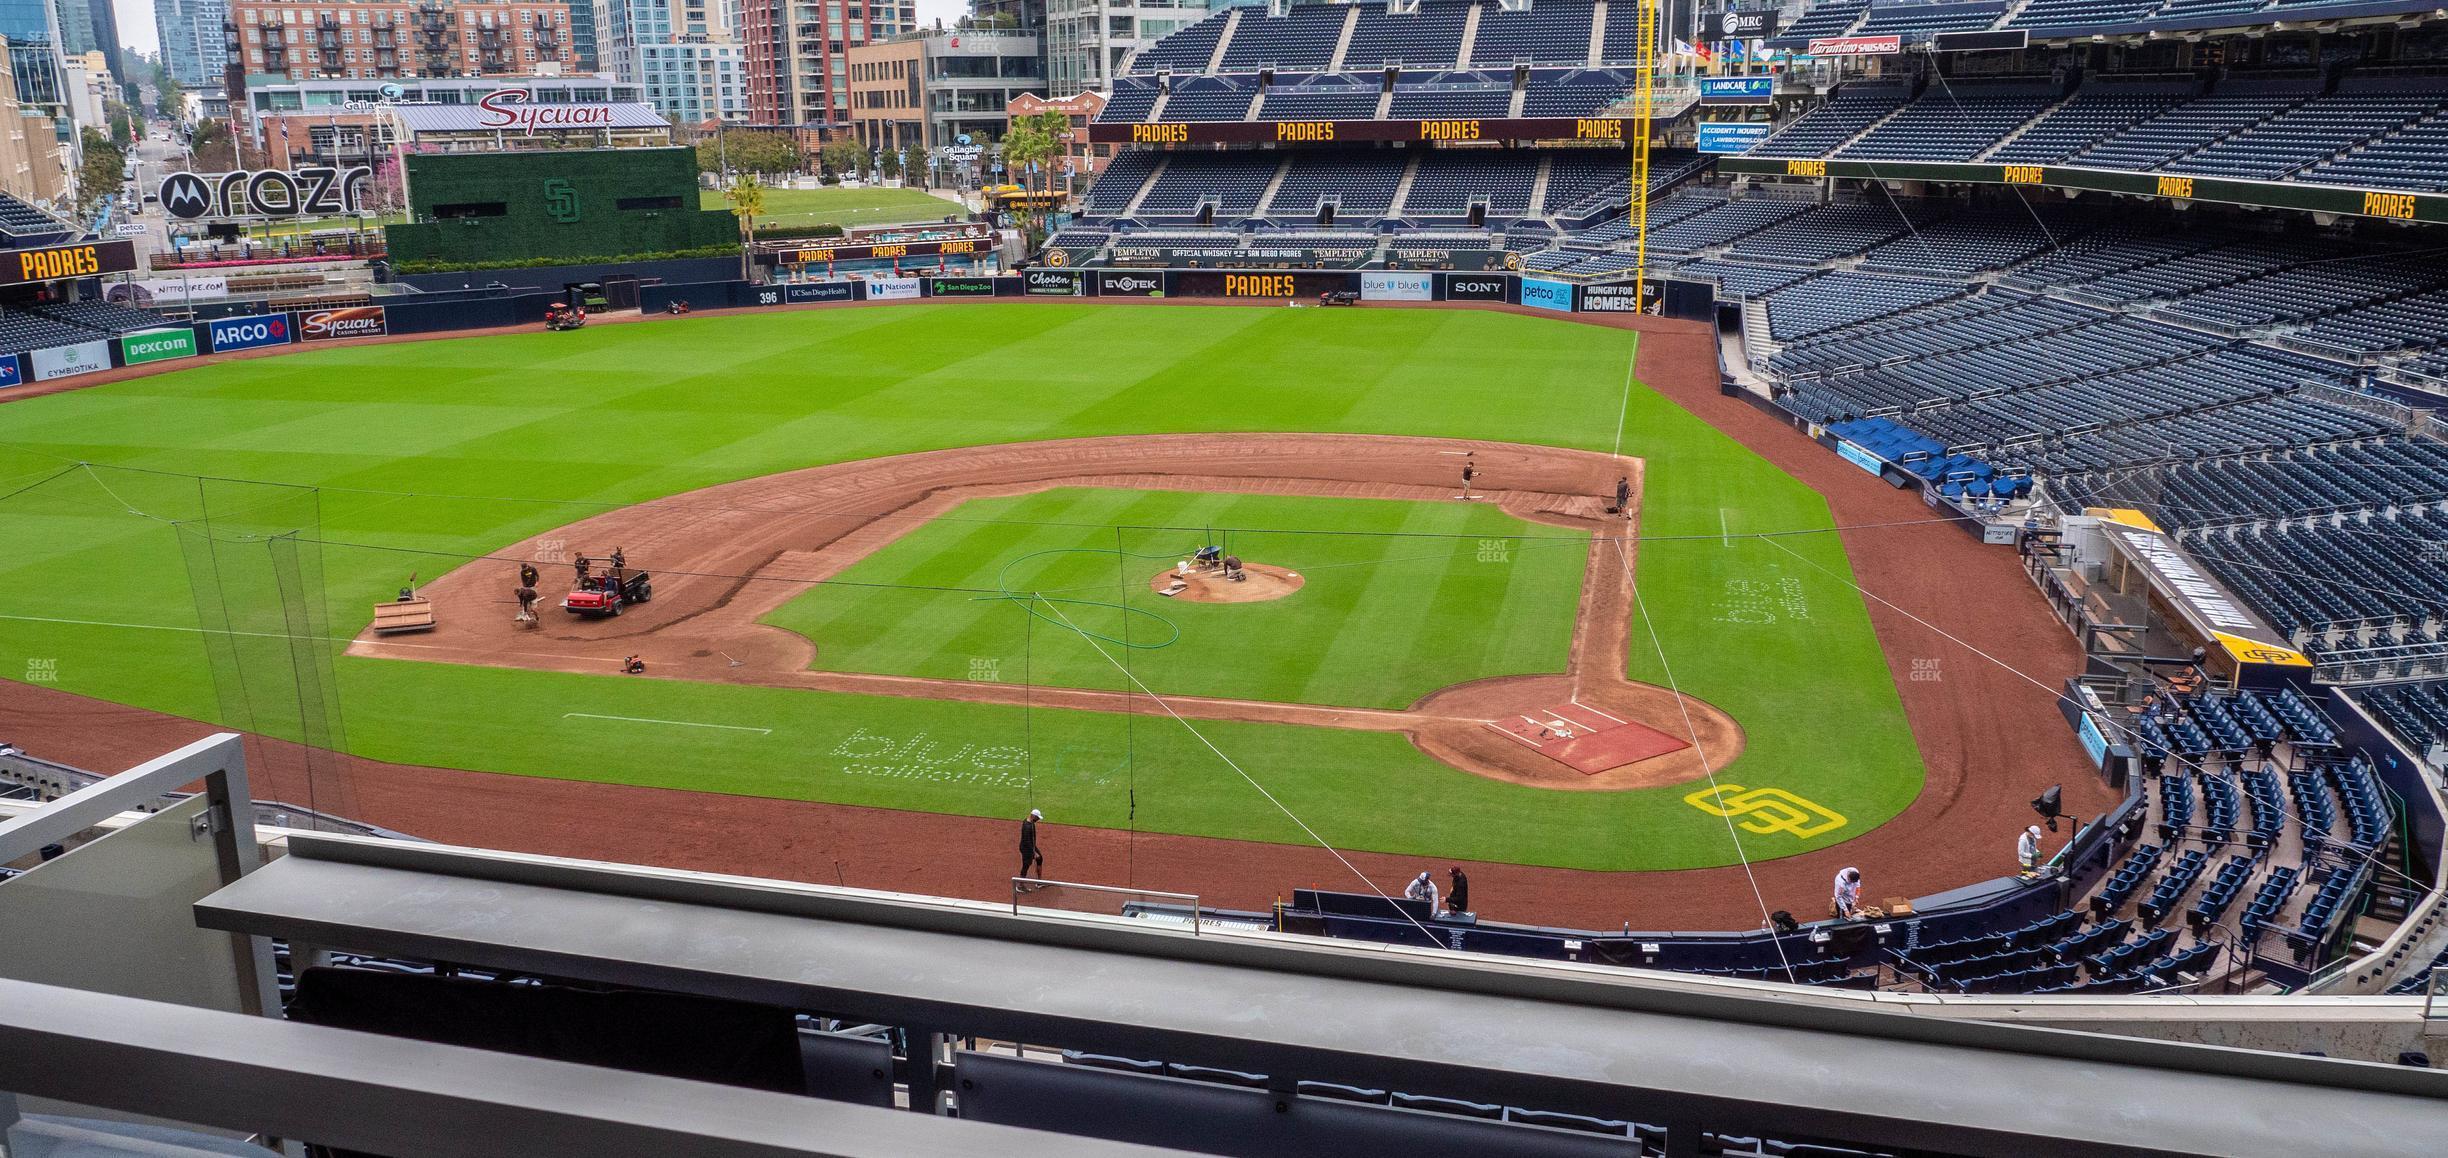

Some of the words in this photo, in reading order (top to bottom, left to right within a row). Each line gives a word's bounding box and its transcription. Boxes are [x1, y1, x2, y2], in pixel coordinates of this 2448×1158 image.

[1739, 16, 1763, 27] MRC
[1811, 41, 1856, 54] Tarantino
[1858, 42, 1897, 53] SAUSAGES
[1713, 81, 1747, 90] LANDCARE
[1749, 80, 1771, 90] LOGIC
[479, 88, 615, 137] Sycuan
[1133, 123, 1188, 142] PADRES
[1277, 122, 1334, 141] PADRES
[1421, 120, 1480, 140] PADRES
[1577, 119, 1622, 139] PADRES
[942, 146, 984, 154] Gallagher
[949, 153, 978, 161] Square
[218, 166, 373, 218] razr
[1787, 160, 1826, 177] PADRES
[2004, 165, 2043, 184] PADRES
[2157, 176, 2193, 198] PADRES
[2364, 192, 2416, 219] PADRES
[544, 177, 582, 224] SD
[119, 224, 144, 233] petco
[799, 249, 835, 262] PADRES
[872, 245, 907, 257] PADRES
[941, 241, 974, 254] PADRES
[1112, 248, 1160, 257] TEMPLETON
[1172, 249, 1201, 257] OFFICIAL
[1202, 249, 1232, 257] WHISKEY
[1247, 249, 1260, 257] SAN
[1261, 249, 1278, 257] DIEGO
[1279, 249, 1302, 257] PADRES
[1313, 249, 1365, 258] TEMPLETON
[1397, 249, 1450, 259] TEMPLETON
[20, 246, 99, 280] PADRES
[1030, 272, 1070, 285] Chosen
[1105, 277, 1157, 291] EVOTEK
[1363, 279, 1385, 290] blue
[1397, 280, 1420, 290] blue
[812, 288, 829, 297] Diego
[828, 287, 847, 296] Health
[885, 282, 917, 291] National
[960, 284, 978, 292] Diego
[1226, 275, 1295, 297] PADRES
[1455, 282, 1501, 293] SONY
[1524, 285, 1554, 299] petco
[1588, 286, 1618, 295] HUNGRY
[1618, 286, 1633, 295] FOR
[759, 292, 778, 304] 396
[1583, 296, 1638, 311] HOMERS
[305, 312, 378, 337] Sycuan
[361, 327, 382, 335] RESORT
[215, 323, 268, 345] ARCO
[47, 362, 99, 378] CYMBIOTIKA
[829, 728, 1029, 769] blue
[1683, 783, 1848, 840] SD
